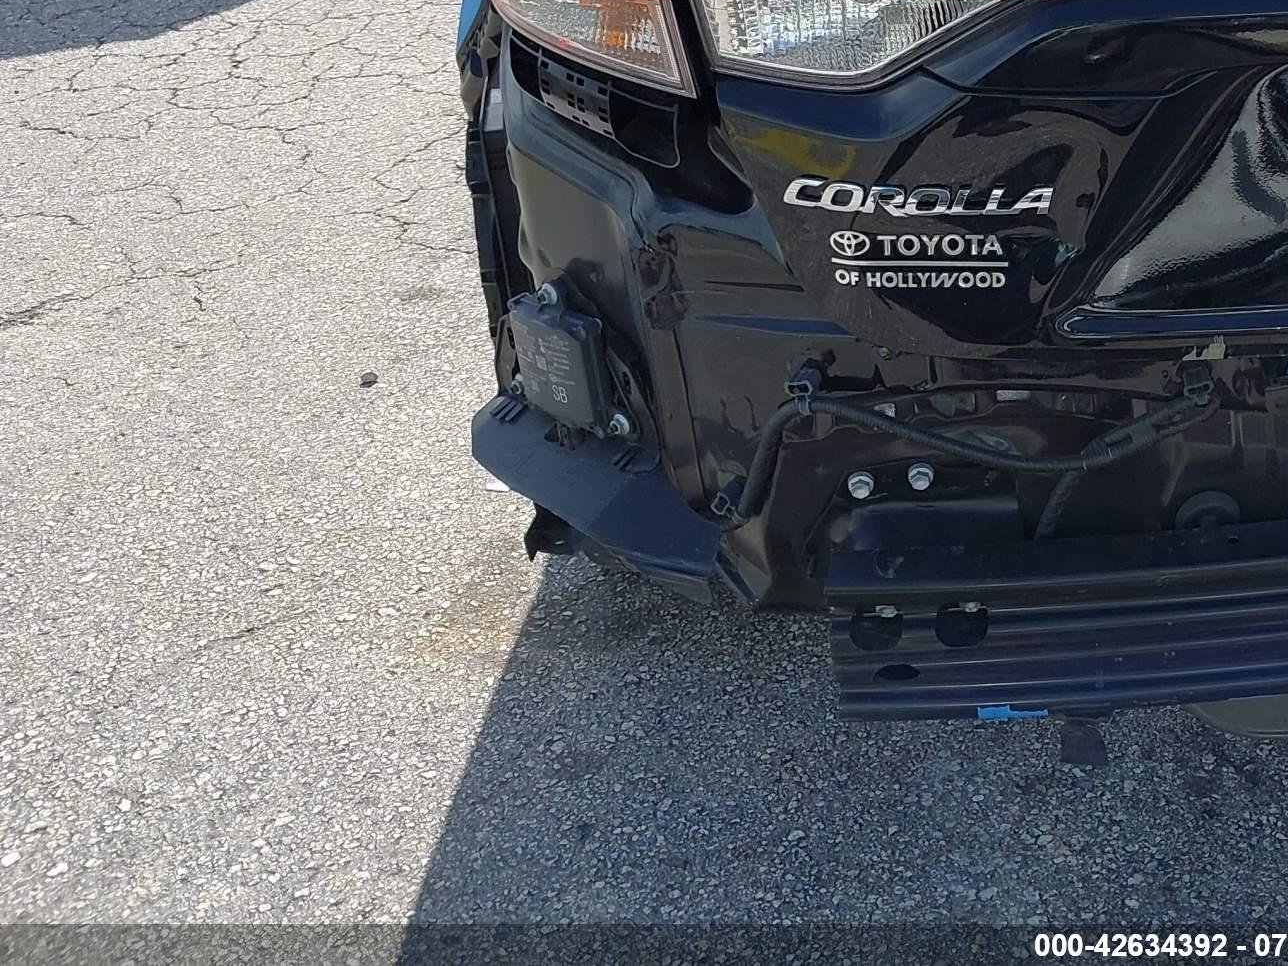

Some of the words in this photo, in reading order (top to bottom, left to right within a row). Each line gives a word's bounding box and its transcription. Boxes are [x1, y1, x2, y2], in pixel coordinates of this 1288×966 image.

[783, 176, 1053, 218] COROLLA
[877, 235, 1003, 256] TOYOTA
[836, 270, 860, 286] OF
[866, 271, 1006, 288] HOLLYWOOD
